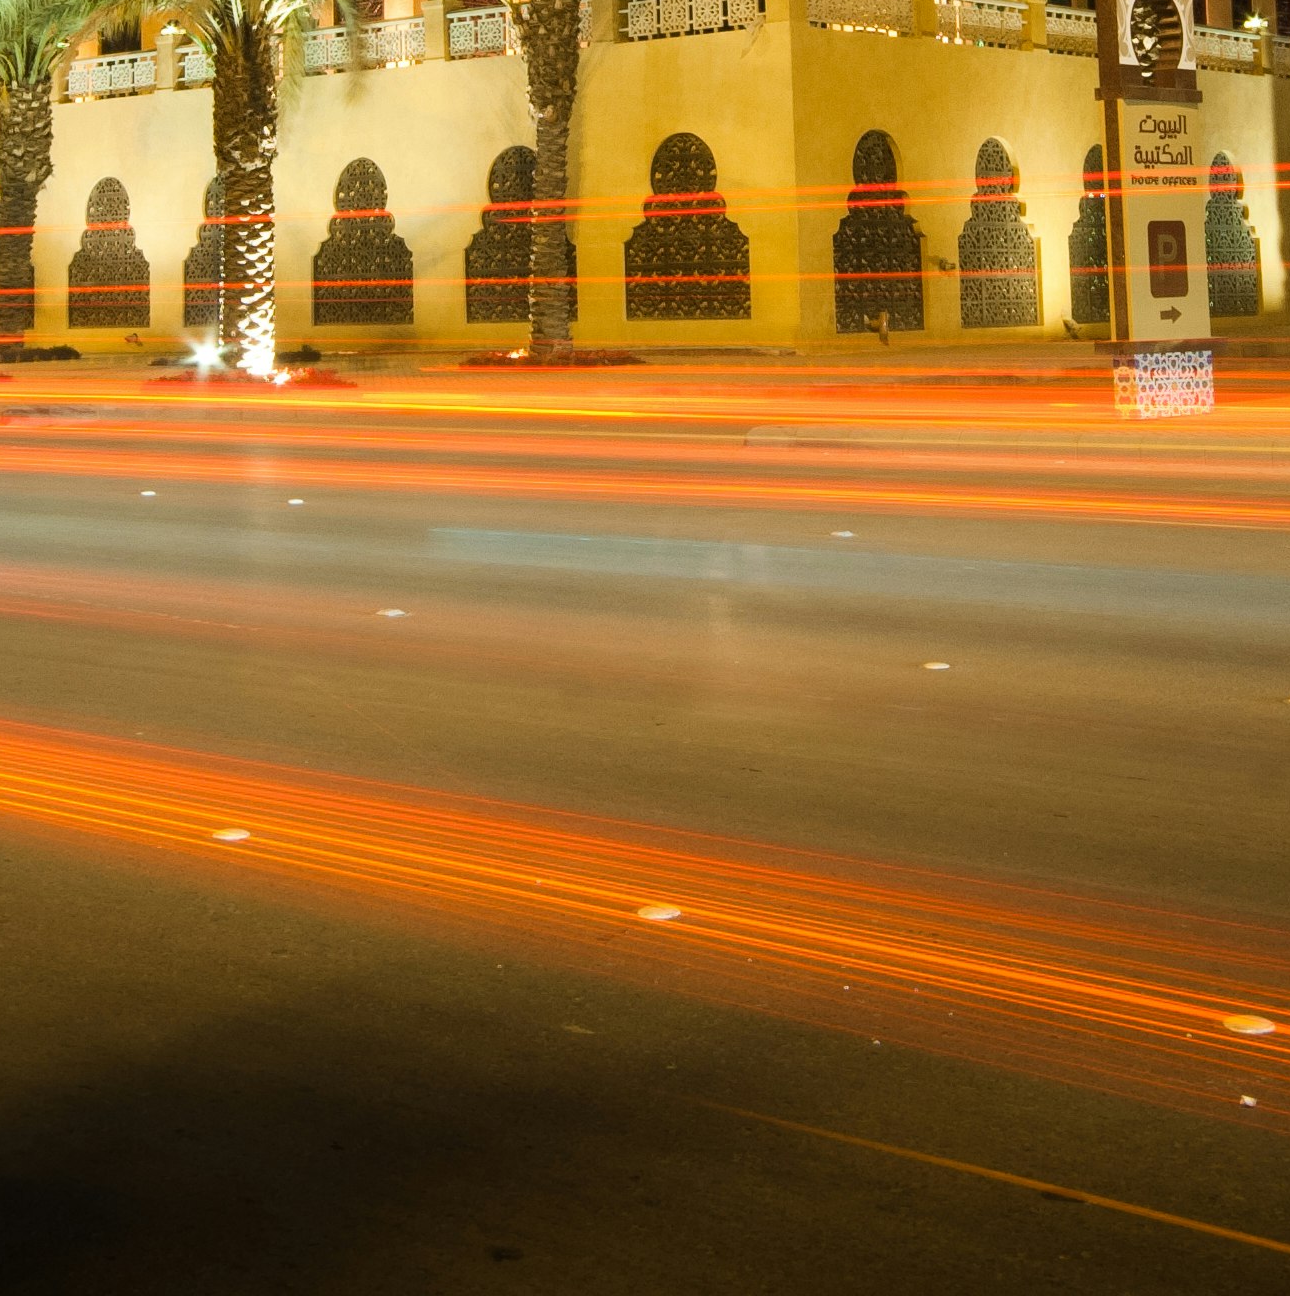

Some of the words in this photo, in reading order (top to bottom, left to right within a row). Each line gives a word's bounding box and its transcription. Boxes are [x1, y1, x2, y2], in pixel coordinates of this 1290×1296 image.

[1139, 114, 1187, 139] البيوت
[1134, 144, 1194, 169] المكتبية
[1157, 234, 1177, 280] P
